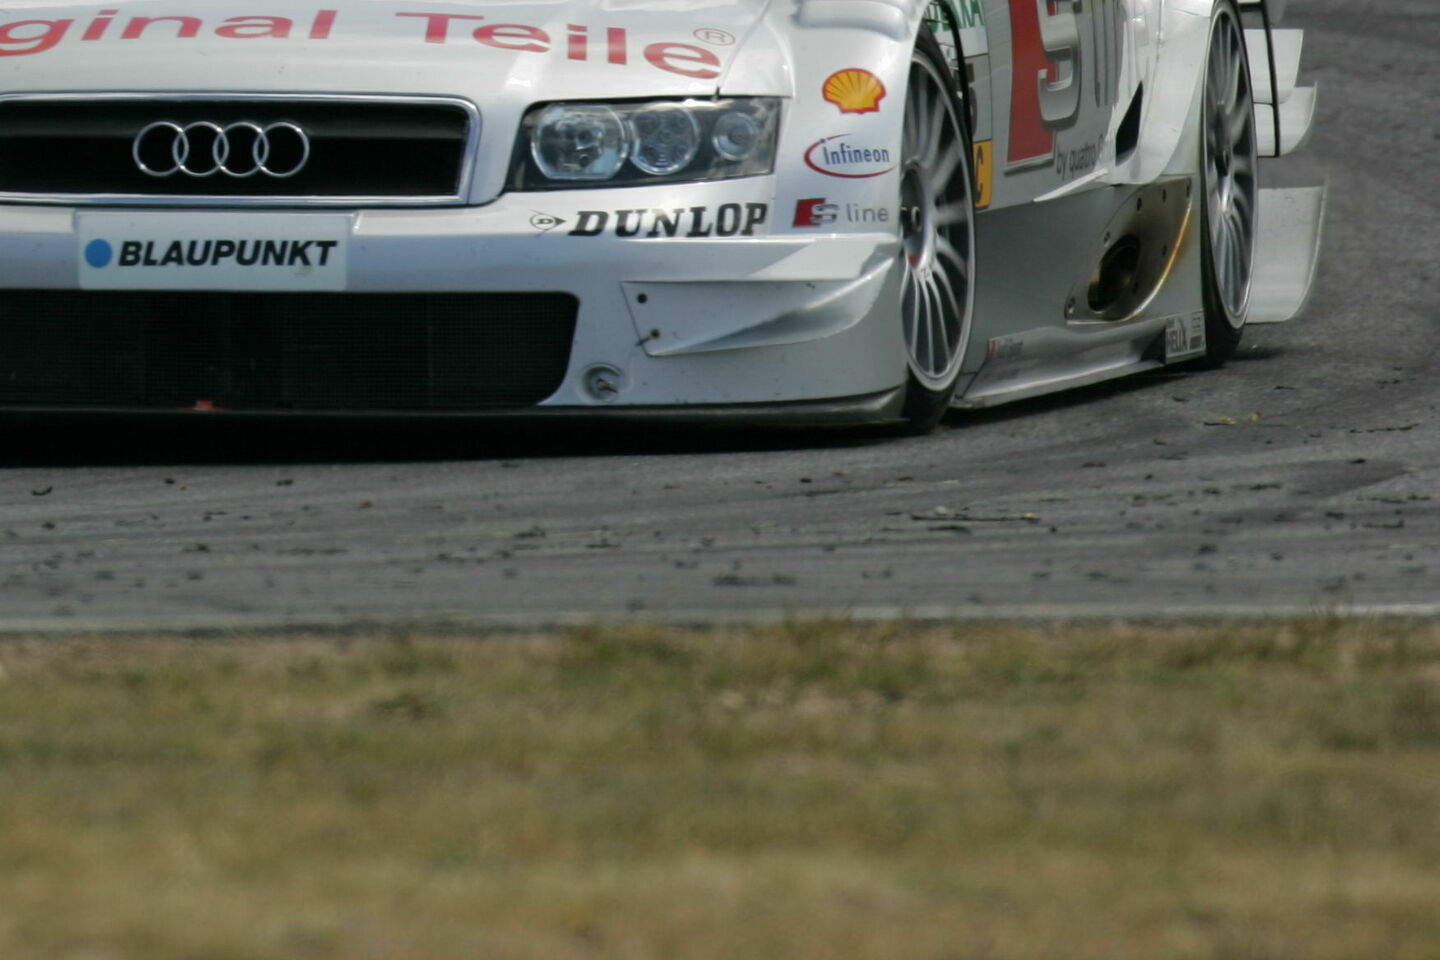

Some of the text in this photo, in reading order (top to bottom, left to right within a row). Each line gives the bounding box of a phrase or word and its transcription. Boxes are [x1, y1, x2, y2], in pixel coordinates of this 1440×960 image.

[821, 138, 890, 164] Infineon
[568, 202, 768, 238] DUNLOP
[846, 203, 890, 224] line
[118, 240, 338, 266] BLAUPUNKT
